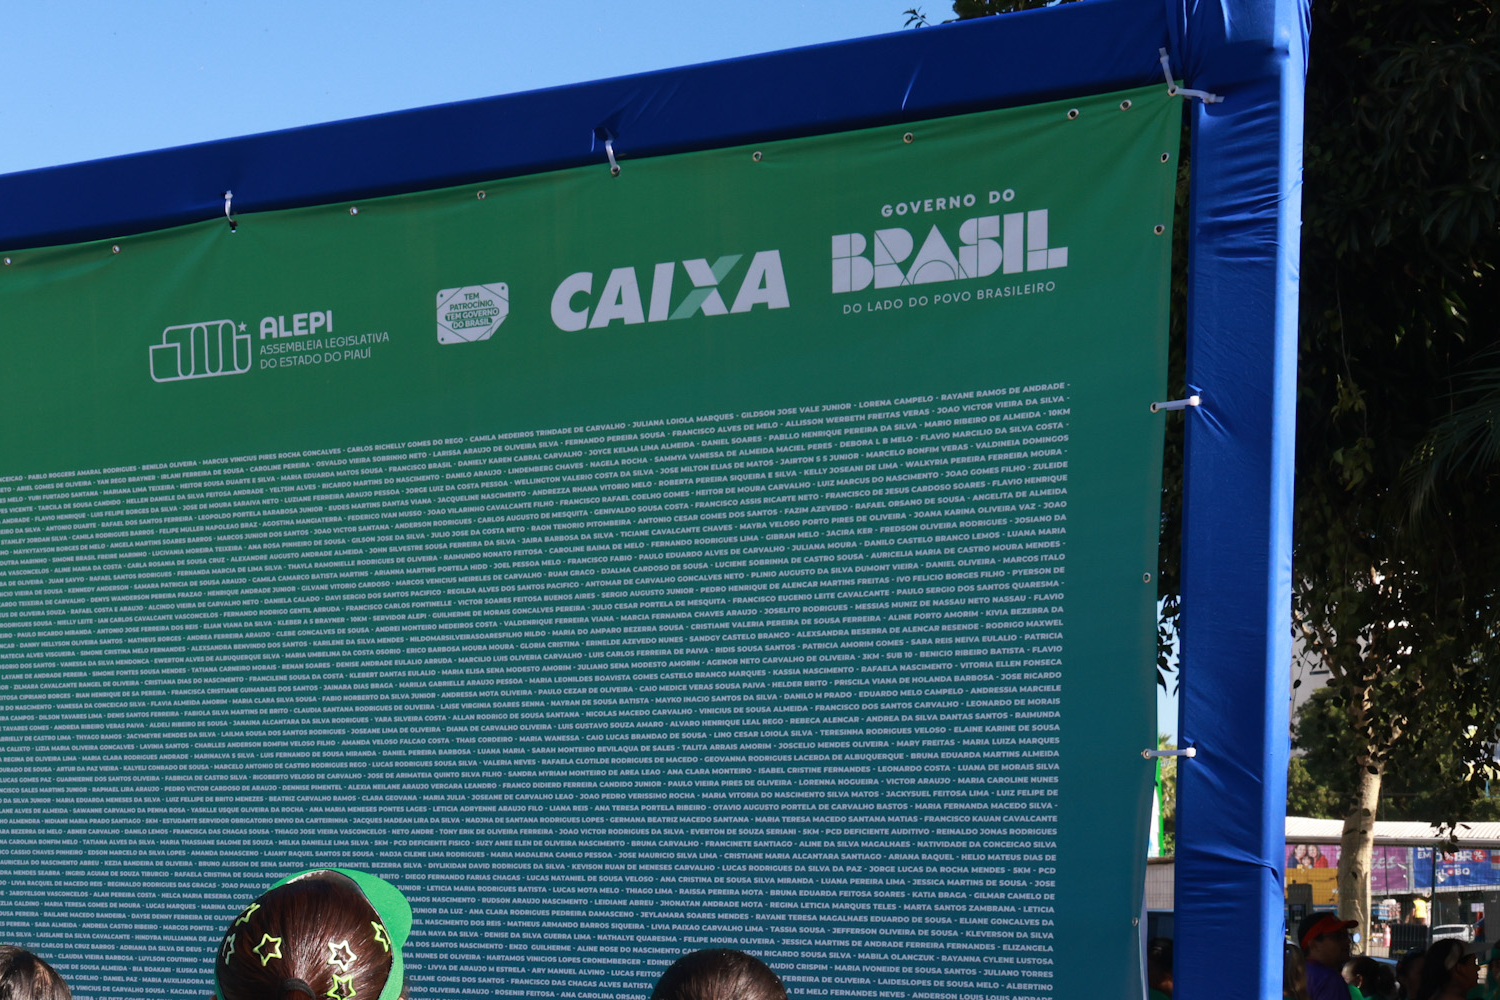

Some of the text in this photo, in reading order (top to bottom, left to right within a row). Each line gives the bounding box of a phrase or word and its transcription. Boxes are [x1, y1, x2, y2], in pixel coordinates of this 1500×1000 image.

[881, 189, 1015, 217] GOVERNO DO
[832, 209, 1068, 294] BRASIL
[464, 292, 480, 300] TEM
[550, 249, 790, 332] CAIXA
[843, 281, 1056, 314] DO LADO DO POVO BRASILEIRO
[260, 310, 333, 340] ALEPI
[447, 308, 498, 321] TEM GOVERNO
[465, 318, 489, 327] BRASIL
[260, 332, 390, 355] ASSEMBLEIA LEGISLATIVA
[260, 347, 372, 369] DO ESTADO DO PIAUÍ
[586, 422, 626, 432] CARVALHO
[632, 419, 664, 428] JULIANA
[666, 417, 694, 425] LOIOLA
[696, 413, 734, 422] MARQUES
[740, 409, 775, 418] GILDSON
[777, 407, 797, 415] JOSE
[799, 405, 819, 413] VALE
[821, 403, 851, 411] JUNIOR
[858, 399, 892, 408] LORENA
[893, 395, 933, 405] CAMPELO
[940, 391, 974, 400] RAYANE
[976, 388, 1006, 397] RAMOS
[1008, 386, 1020, 394] DE
[1022, 382, 1064, 392] ANDRADE
[924, 419, 952, 427] MARIO
[953, 416, 987, 425] RIBEIRO
[1002, 411, 1041, 420] ALMEIDA
[1048, 408, 1070, 416] 10KM
